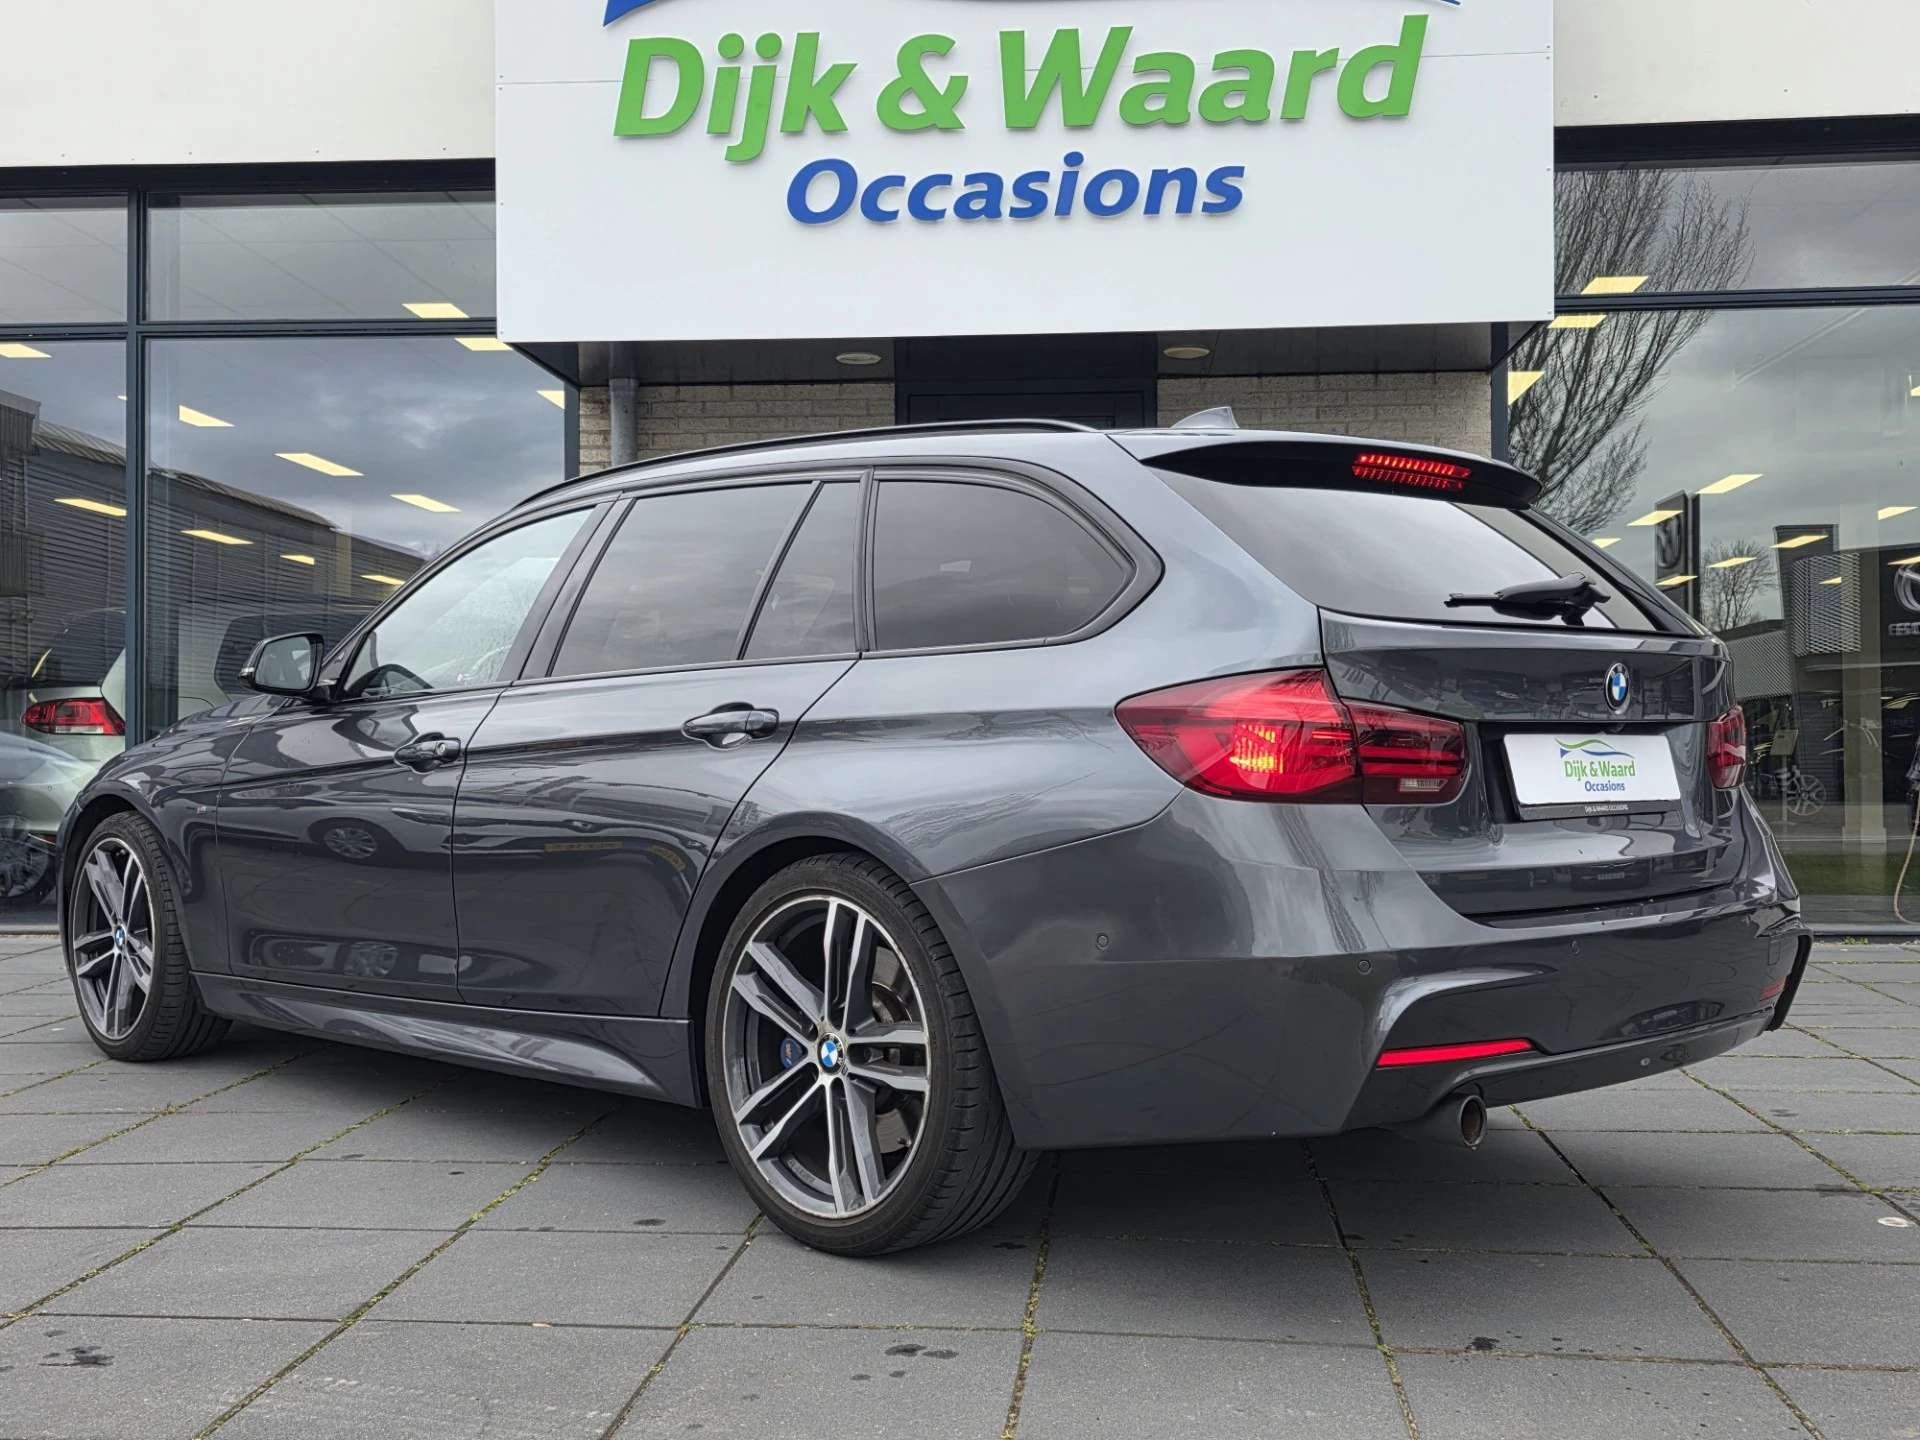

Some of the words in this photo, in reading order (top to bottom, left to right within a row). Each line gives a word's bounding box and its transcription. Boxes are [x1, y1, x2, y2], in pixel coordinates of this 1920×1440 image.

[614, 32, 856, 162] Dijk
[877, 34, 969, 131] &
[1000, 14, 1429, 128] Waard
[786, 151, 1246, 225] Occasions
[1564, 760, 1588, 781] Dijk
[1589, 761, 1598, 777] &
[1599, 760, 1636, 777] Waard
[1584, 780, 1626, 792] Occasions
